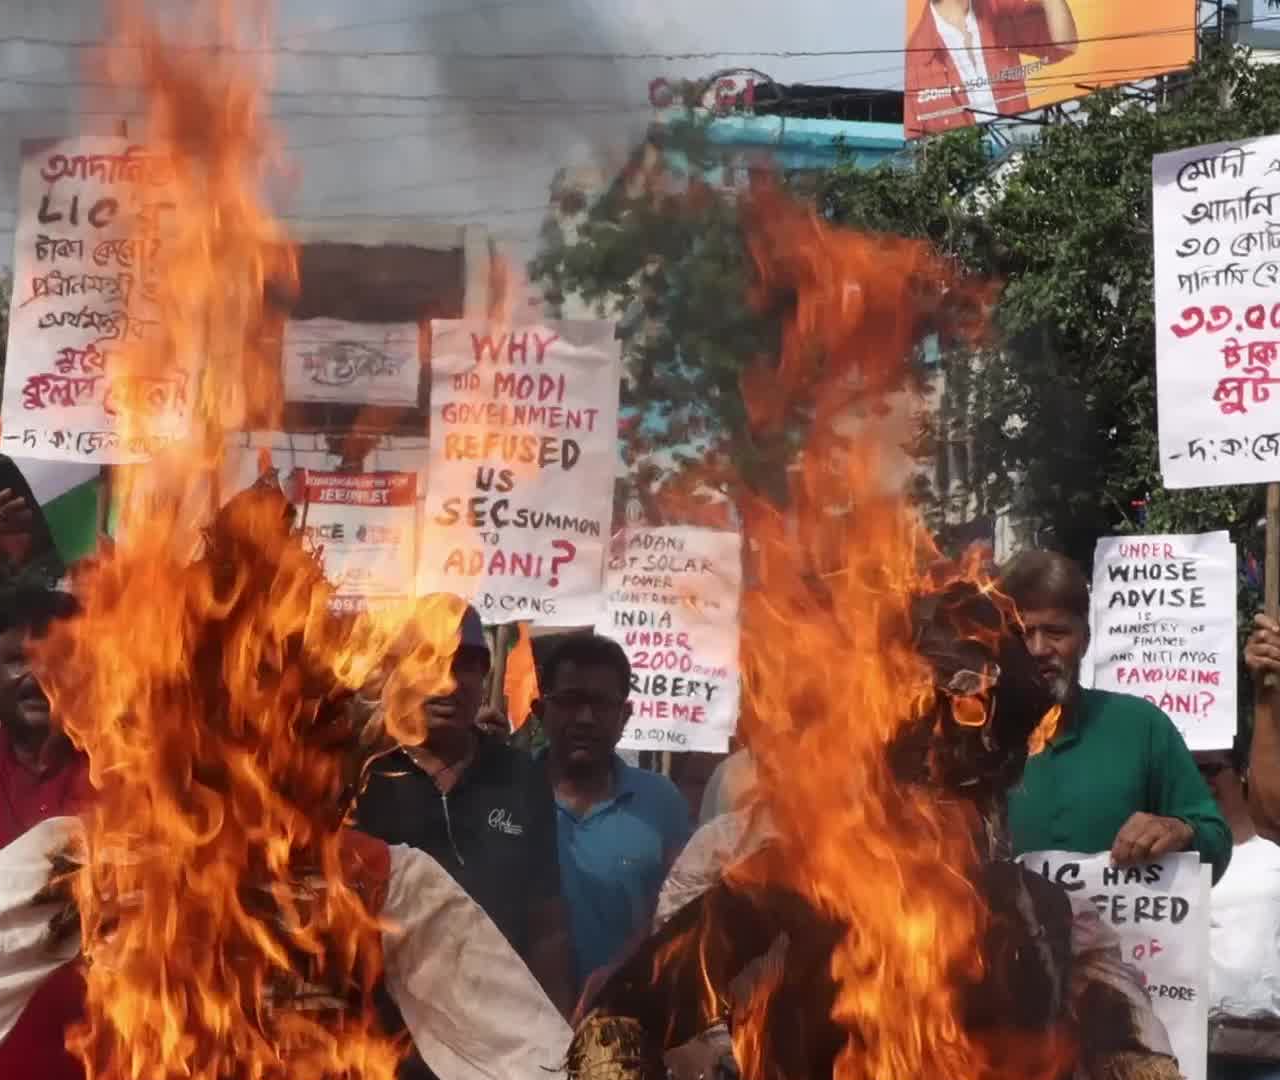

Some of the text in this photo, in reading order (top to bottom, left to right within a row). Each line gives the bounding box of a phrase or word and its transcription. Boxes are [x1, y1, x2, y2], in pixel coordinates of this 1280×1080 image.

[38, 195, 118, 228] LIC
[1176, 237, 1220, 258] ৩০
[472, 331, 560, 365] WHY
[493, 372, 565, 402] MODI
[441, 402, 599, 432] GOVERNMENT
[445, 432, 581, 470] REFUSED
[476, 466, 515, 493] US
[434, 496, 601, 537] SEC SUMMON
[481, 532, 499, 545] TO
[1119, 543, 1175, 560] UNDER
[443, 540, 577, 588] ADANI?
[642, 555, 714, 574] SOLAR
[1108, 562, 1197, 582] WHOSE
[1108, 587, 1207, 608] ADVISE
[614, 610, 672, 628] INDIA
[1138, 611, 1151, 621] IS
[1109, 623, 1205, 634] MINISTRY OF
[625, 632, 692, 651] UNDER
[1133, 634, 1186, 646] FINANCE
[632, 651, 692, 674] 2000
[1110, 650, 1218, 664] AND NITI AYOG
[1116, 667, 1222, 686] FAVOURING
[628, 674, 718, 701] RIBERY
[626, 700, 706, 724] HEME
[1041, 861, 1163, 892] IC HAS
